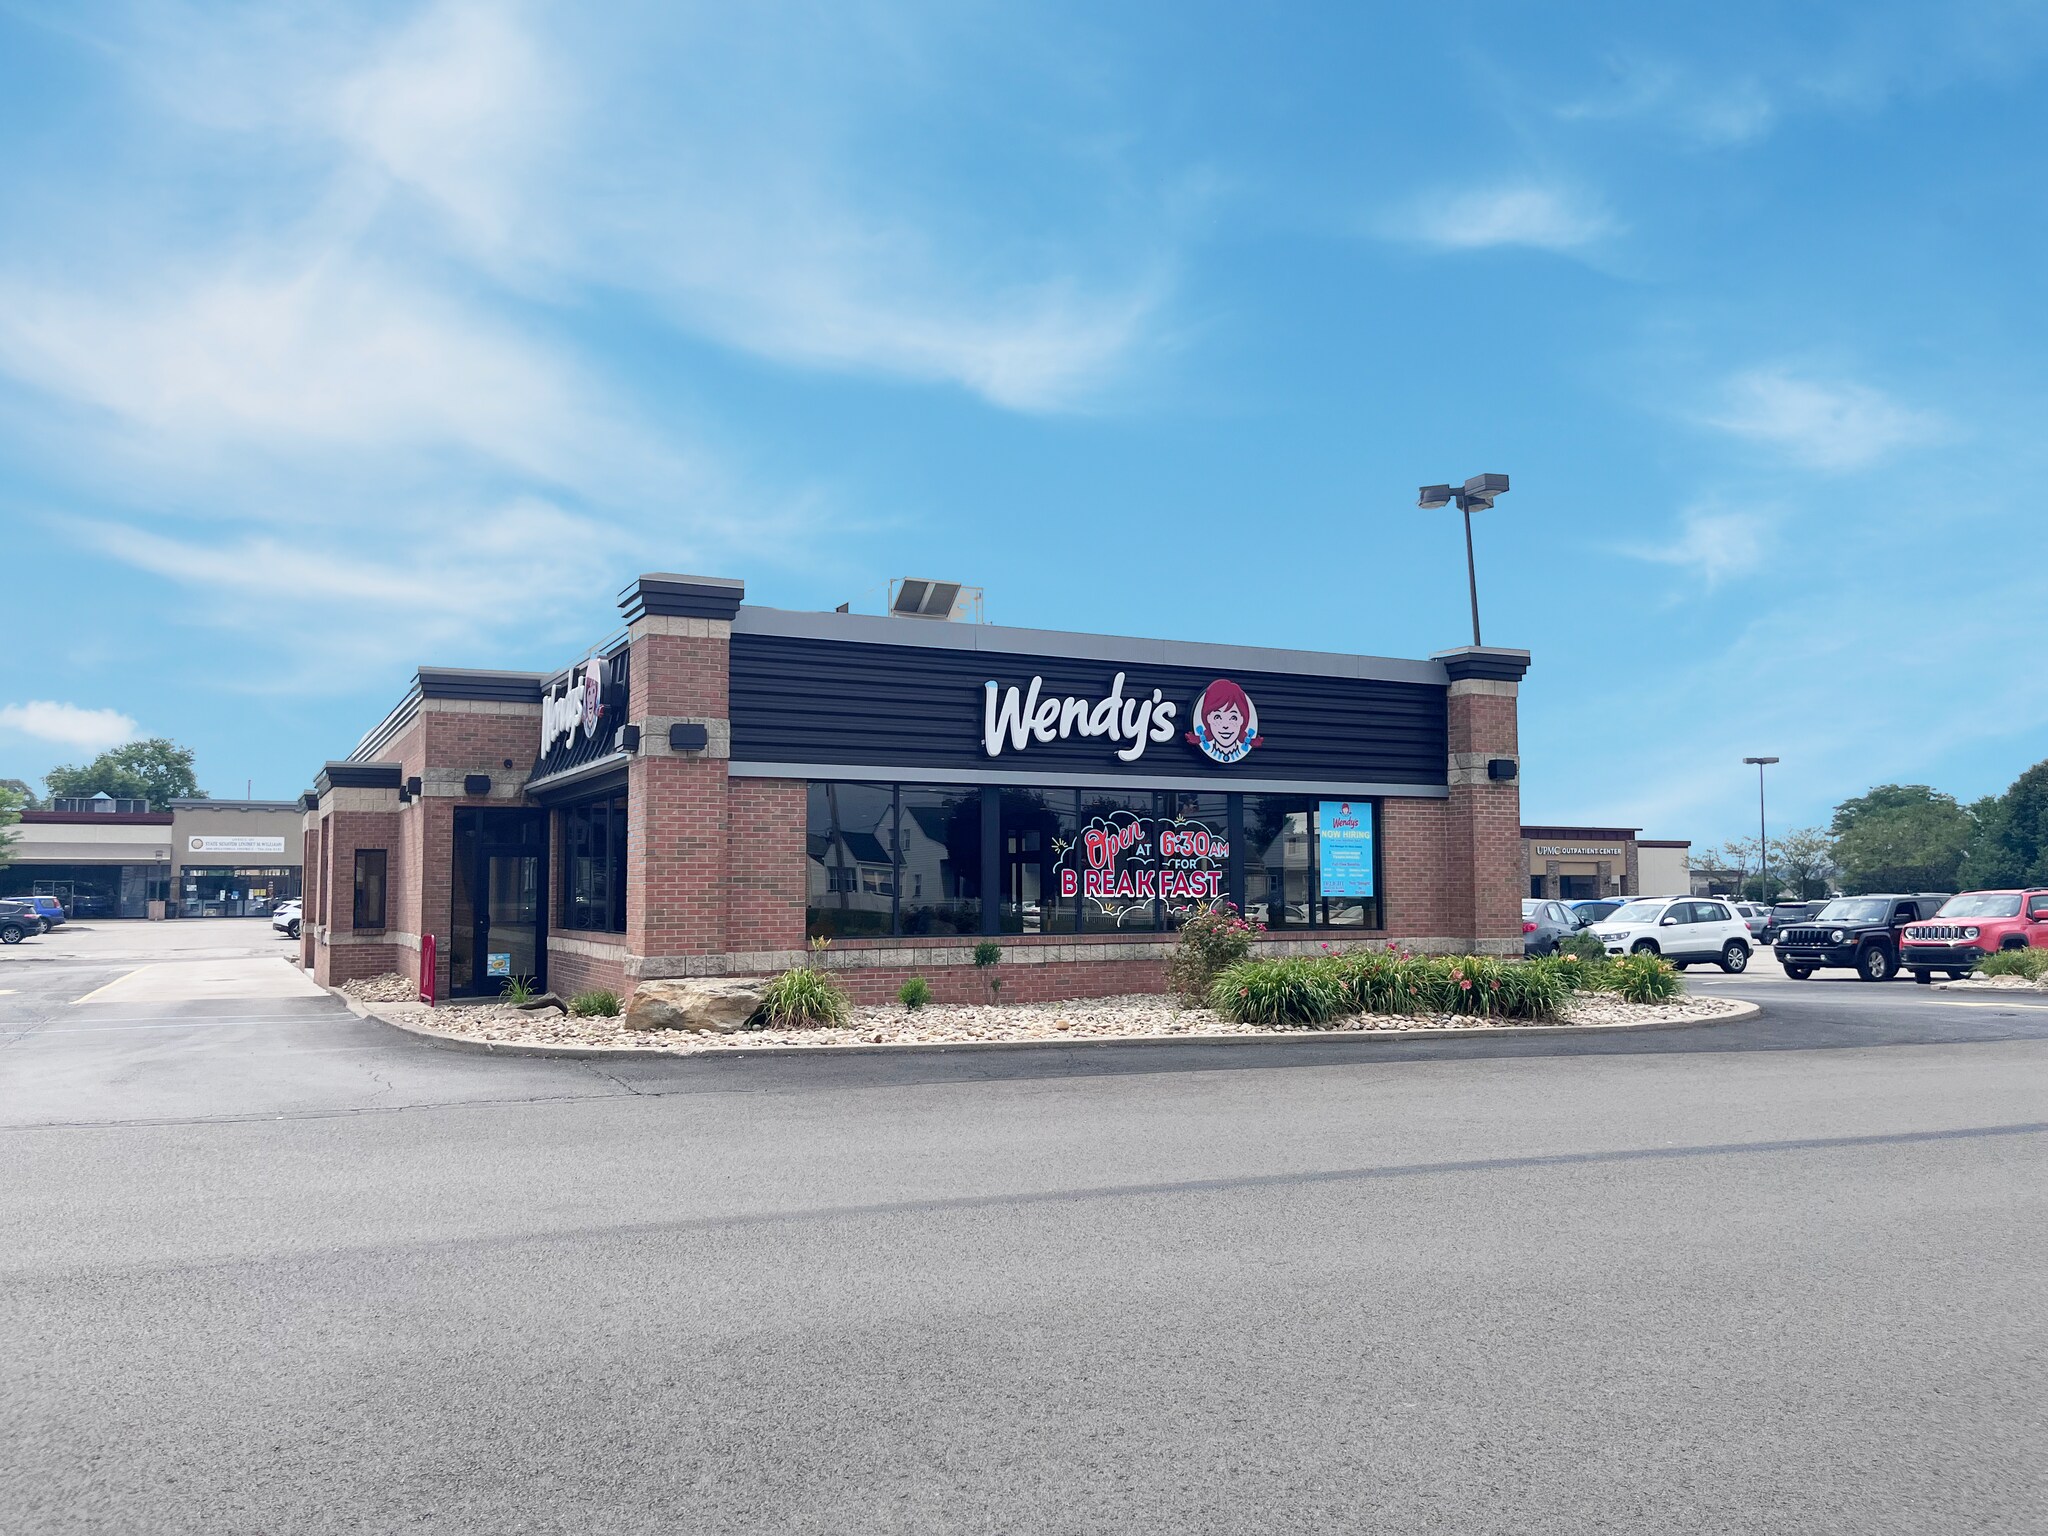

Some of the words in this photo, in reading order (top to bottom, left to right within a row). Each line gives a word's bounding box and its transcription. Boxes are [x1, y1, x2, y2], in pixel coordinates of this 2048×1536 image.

[984, 671, 1177, 762] Wendy's
[1333, 816, 1359, 829] Wendy's
[1321, 830, 1341, 839] NOW
[1343, 831, 1370, 840] HIRING
[1085, 821, 1145, 871] Open
[1135, 843, 1152, 856] AT
[1536, 846, 1560, 855] UPMC
[1561, 847, 1599, 855] OUTPATIENT
[1175, 860, 1197, 869] FOR
